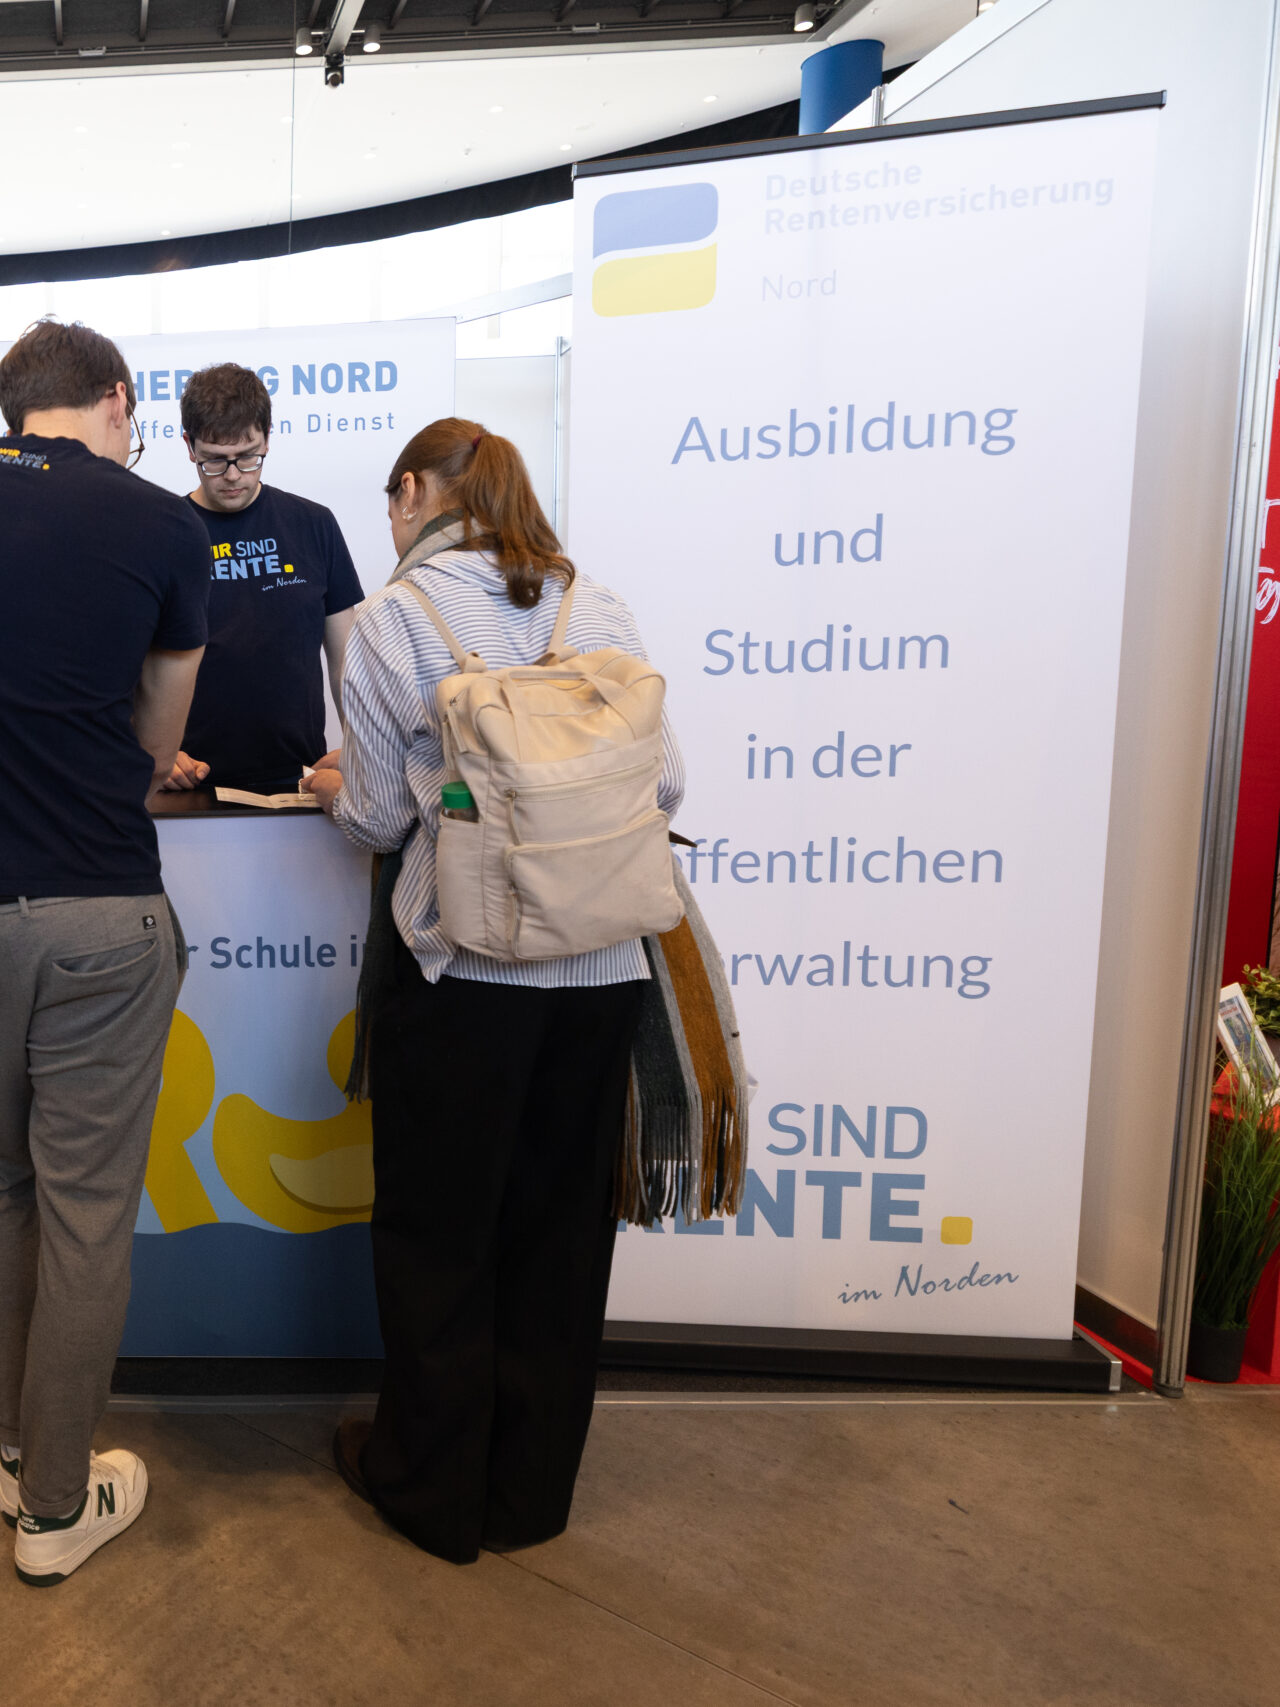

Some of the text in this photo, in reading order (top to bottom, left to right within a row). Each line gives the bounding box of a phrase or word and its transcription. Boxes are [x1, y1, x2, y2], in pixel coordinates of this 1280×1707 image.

[765, 161, 923, 202] Deutsche
[764, 178, 1115, 234] Rentenversicherung
[761, 269, 837, 302] Nord
[292, 360, 398, 396] NORD
[307, 411, 395, 433] Dienst
[671, 401, 1018, 464] Ausbildung
[210, 538, 277, 560] IR SIND
[774, 513, 884, 566] und
[276, 575, 308, 588] Norden
[702, 624, 949, 676] Studium
[747, 730, 913, 779] in der
[671, 836, 1004, 884] ffentlichen
[209, 935, 338, 969] Schule
[350, 934, 367, 968] i
[721, 940, 993, 1000] rwaltung
[765, 1102, 929, 1160] SIND
[837, 1260, 1020, 1305] im Norden
